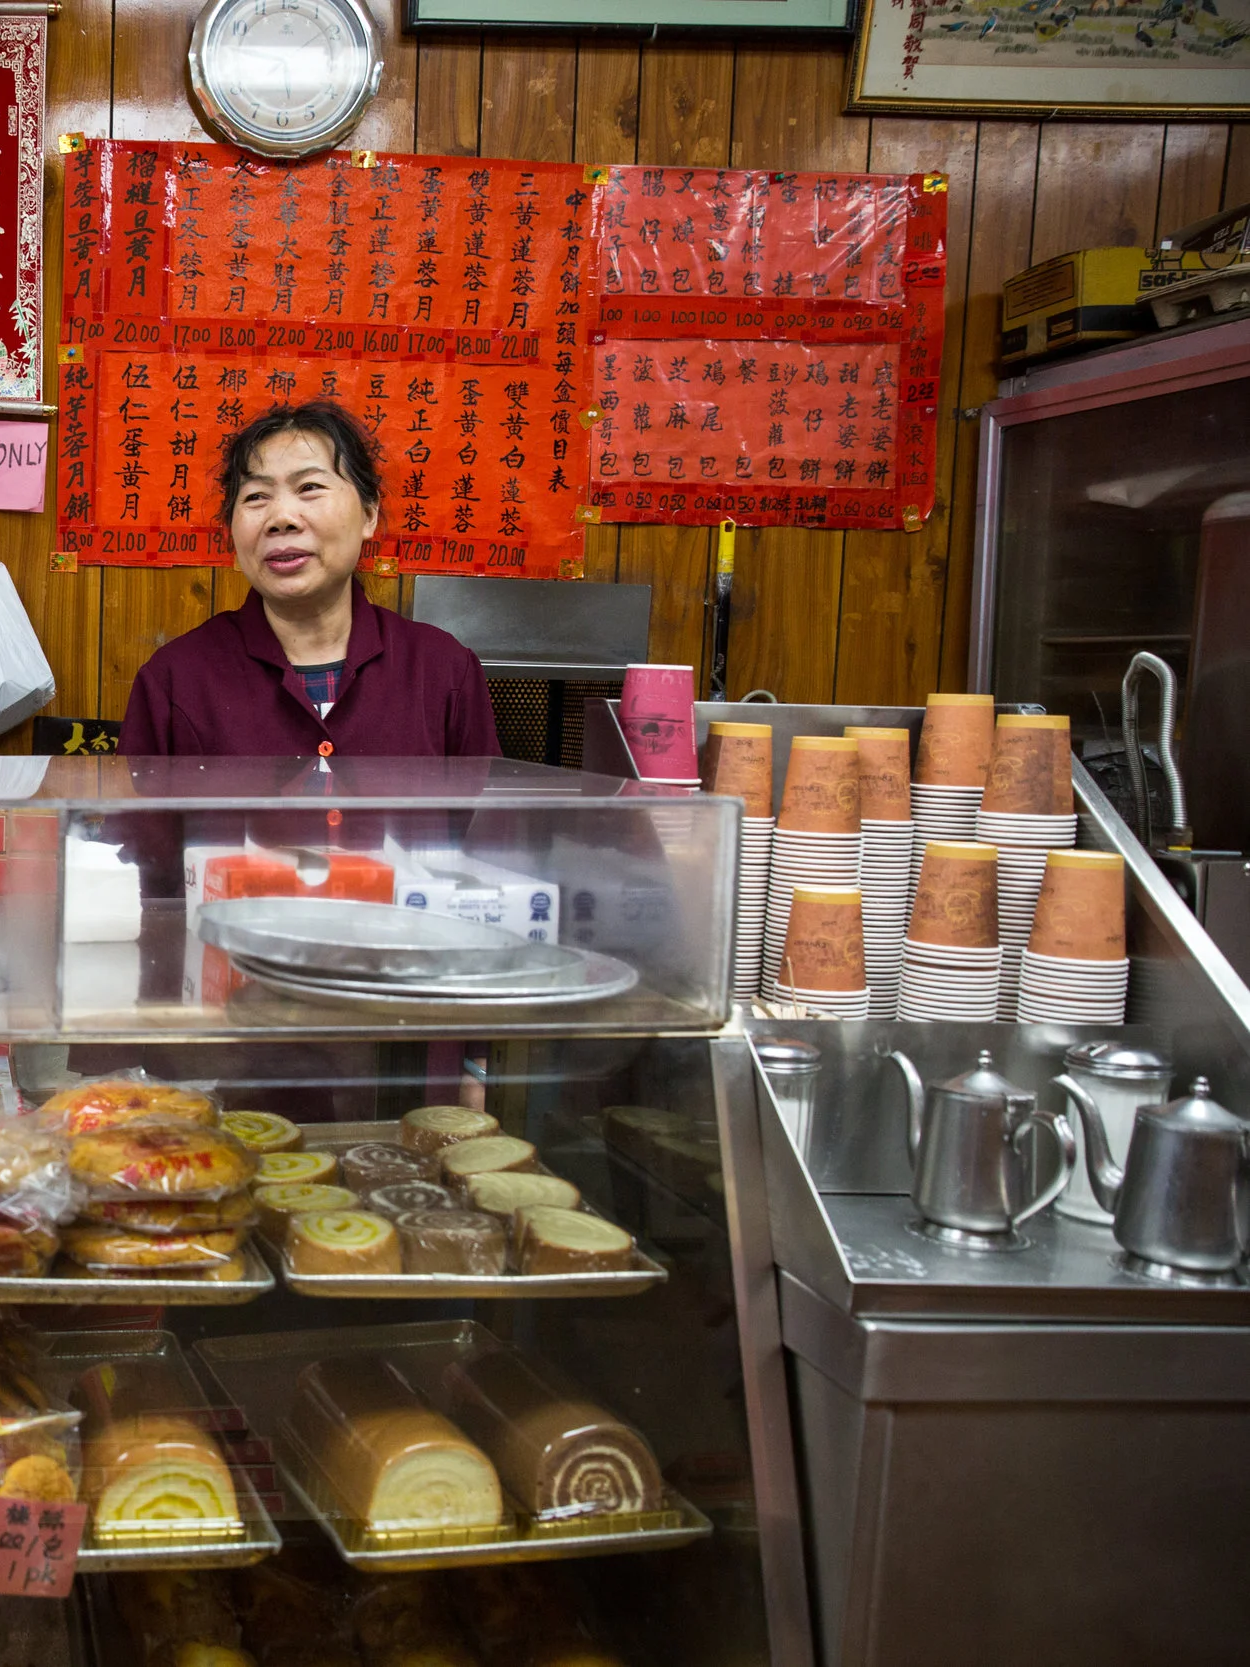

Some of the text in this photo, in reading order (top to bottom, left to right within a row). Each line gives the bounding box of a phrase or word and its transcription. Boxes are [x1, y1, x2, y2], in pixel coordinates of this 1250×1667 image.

[113, 318, 160, 344] 20.00
[219, 326, 257, 347] 18.00
[314, 327, 355, 352] 23.00
[363, 328, 400, 353] 16.00
[455, 334, 491, 356] 18.00
[157, 531, 197, 553] 20.00
